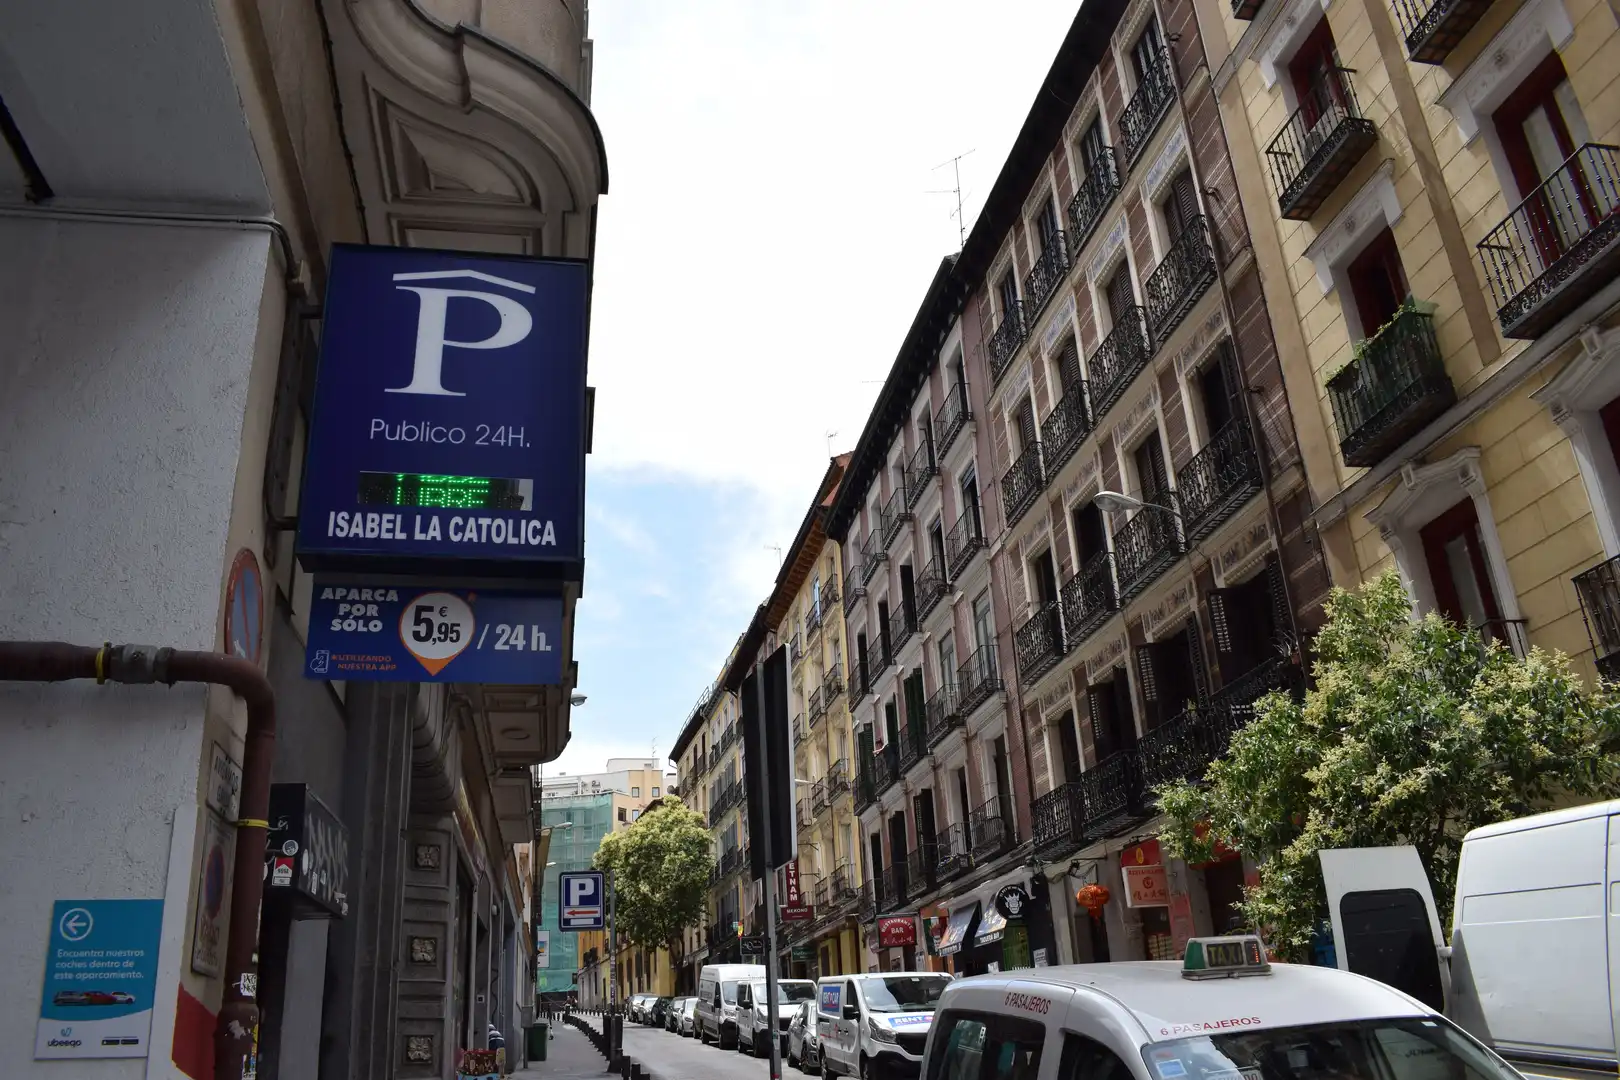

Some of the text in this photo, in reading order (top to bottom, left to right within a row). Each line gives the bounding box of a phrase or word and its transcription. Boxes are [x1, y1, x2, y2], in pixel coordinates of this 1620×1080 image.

[385, 286, 533, 396] P
[370, 418, 531, 448] Publico 24H.
[328, 511, 556, 546] ISABEL LA CATOLICA
[320, 587, 398, 601] APARCA
[338, 603, 379, 617] POR
[330, 614, 384, 632] SÓLO
[412, 606, 460, 645] 5,95
[494, 624, 526, 651] 24
[531, 626, 552, 652] h.
[337, 662, 396, 671] NUESTRA APP
[570, 878, 594, 906] P
[881, 918, 914, 932] RESTAURANTE
[890, 926, 904, 934] BAR
[57, 948, 144, 958] Encuentra nuestros
[1208, 946, 1242, 966] TAXI
[56, 960, 134, 968] coches dentro de
[54, 971, 144, 982] este aparcamiento.
[1004, 992, 1052, 1015] 6 PASAJEROS
[895, 1016, 924, 1024] RENT
[1160, 1016, 1262, 1036] 6 PASAJEROS
